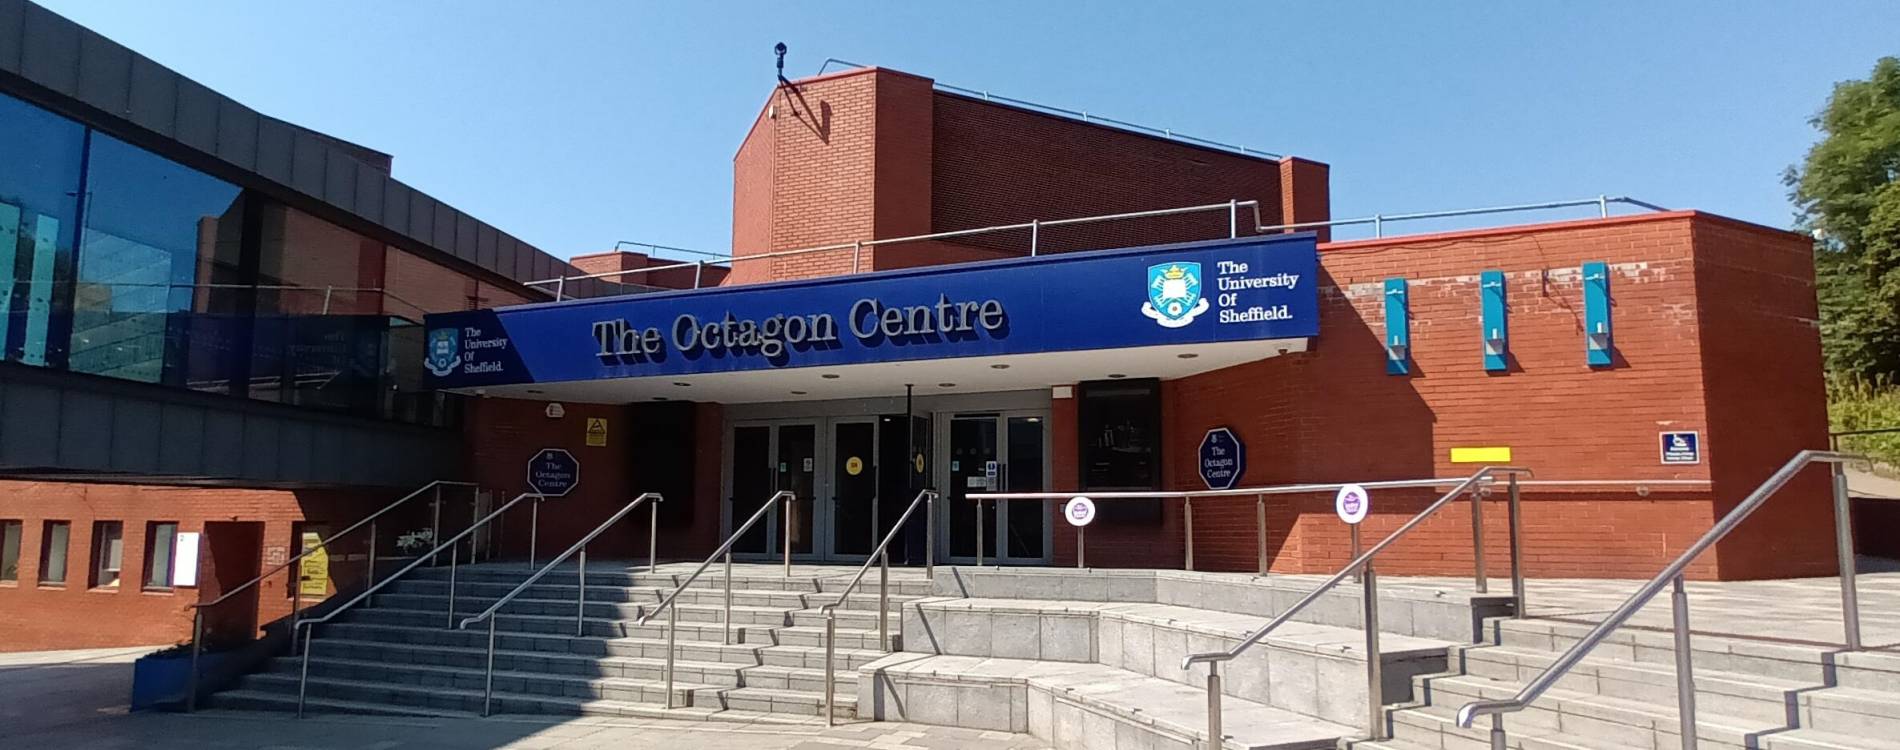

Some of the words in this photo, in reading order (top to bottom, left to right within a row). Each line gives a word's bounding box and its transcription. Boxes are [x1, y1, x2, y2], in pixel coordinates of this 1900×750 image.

[1217, 261, 1248, 275] The
[1217, 273, 1299, 291] University
[1218, 293, 1237, 307] Of
[1219, 305, 1293, 323] Sheffield.
[464, 327, 481, 337] The
[592, 318, 661, 357] The
[671, 310, 837, 357] Octagon
[849, 293, 1003, 339] Centre
[464, 338, 508, 349] University
[464, 351, 475, 361] Of
